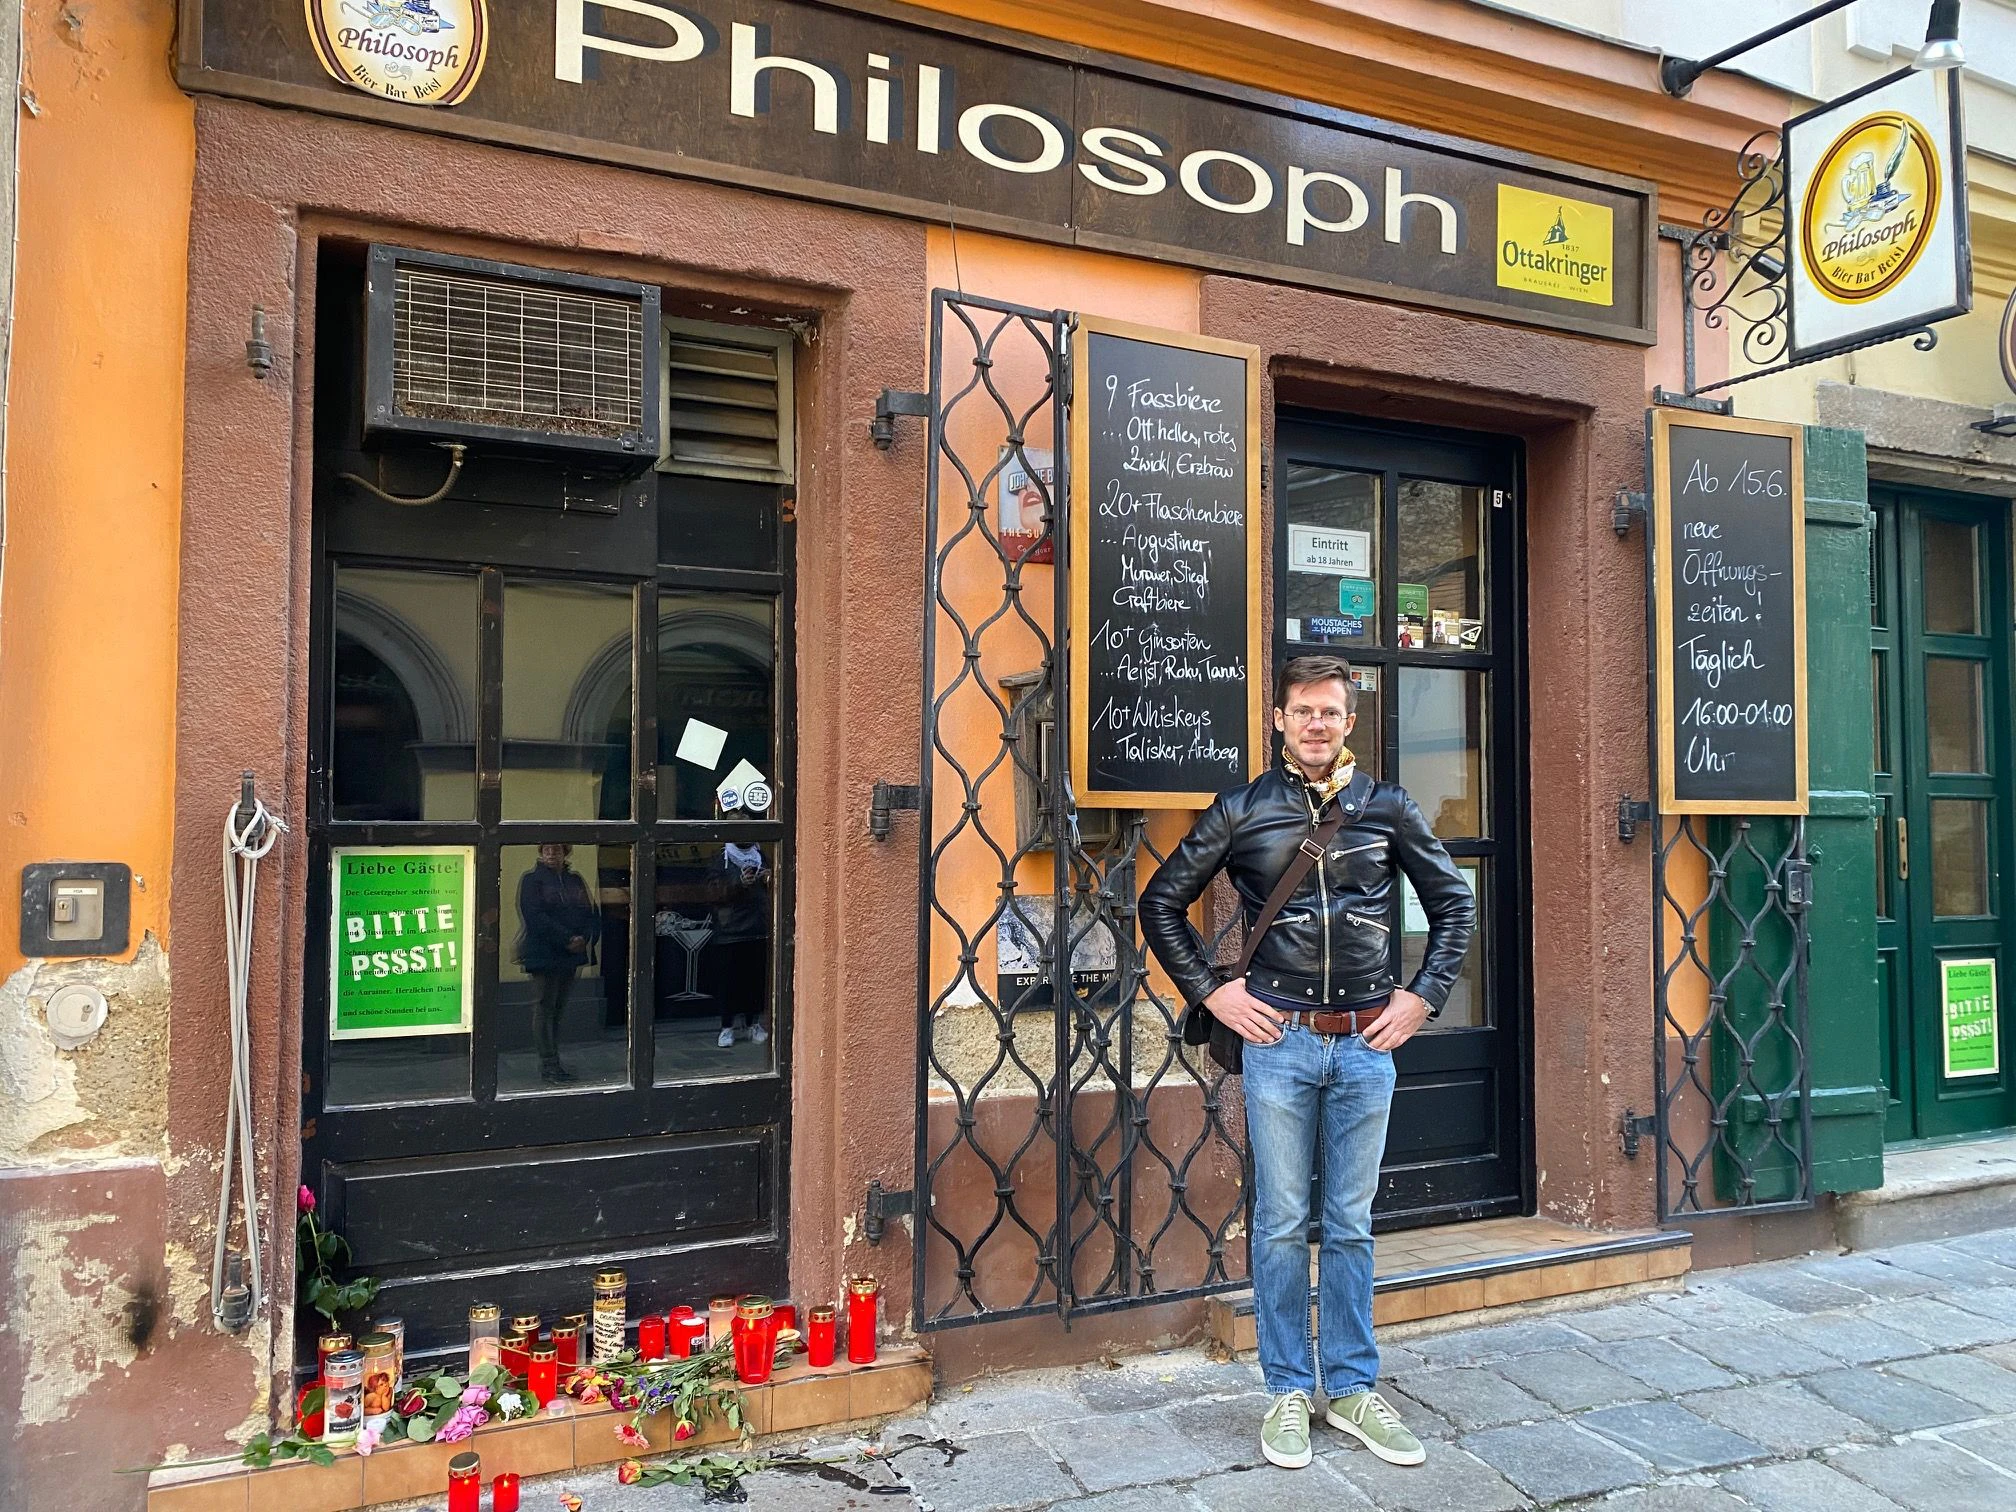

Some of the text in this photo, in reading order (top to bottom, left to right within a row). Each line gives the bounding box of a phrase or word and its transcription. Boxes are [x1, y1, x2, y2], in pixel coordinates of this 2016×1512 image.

[338, 27, 459, 73] Philosoph
[352, 64, 442, 99] Bier Bar Beisl
[555, 0, 1457, 254] Philosoph
[1562, 244, 1580, 253] 1837
[1822, 209, 1917, 262] Philosoph
[1503, 240, 1607, 285] Ottakringer
[1832, 246, 1906, 285] Bier Bar Beisl
[1523, 278, 1589, 294] BRAUEREI WIEN
[1106, 375, 1223, 413] 9 Fassbiere
[1682, 458, 1719, 495] Ab
[1142, 493, 1243, 526] Flaschenbiere
[1001, 527, 1021, 538] THE
[1312, 537, 1349, 551] Eintritt
[1683, 520, 1722, 540] neue
[1306, 555, 1353, 567] ab 18 Jahren
[1113, 586, 1192, 613] Craftbiere
[1311, 618, 1362, 629] MOUSTACHES
[1320, 625, 1352, 636] HAPPEN
[1091, 619, 1211, 662] 10+ Ginsorten
[1678, 634, 1766, 688] Täglich
[1132, 695, 1211, 740] Whiskeys
[1187, 739, 1238, 774] Ardbeg
[1683, 735, 1736, 773] Uhr
[347, 861, 459, 875] Liebe Gäste!
[345, 889, 359, 897] Der
[363, 888, 407, 897] Gesetzgeber
[346, 903, 455, 944] BITTE
[351, 941, 457, 981] PSSST!
[395, 986, 434, 994] Herzlichen
[437, 984, 456, 993] Dank
[1080, 973, 1100, 983] THE
[384, 1007, 414, 1015] Stunden
[1949, 994, 1991, 1020] BITTE
[1952, 1016, 1993, 1043] PSSST!
